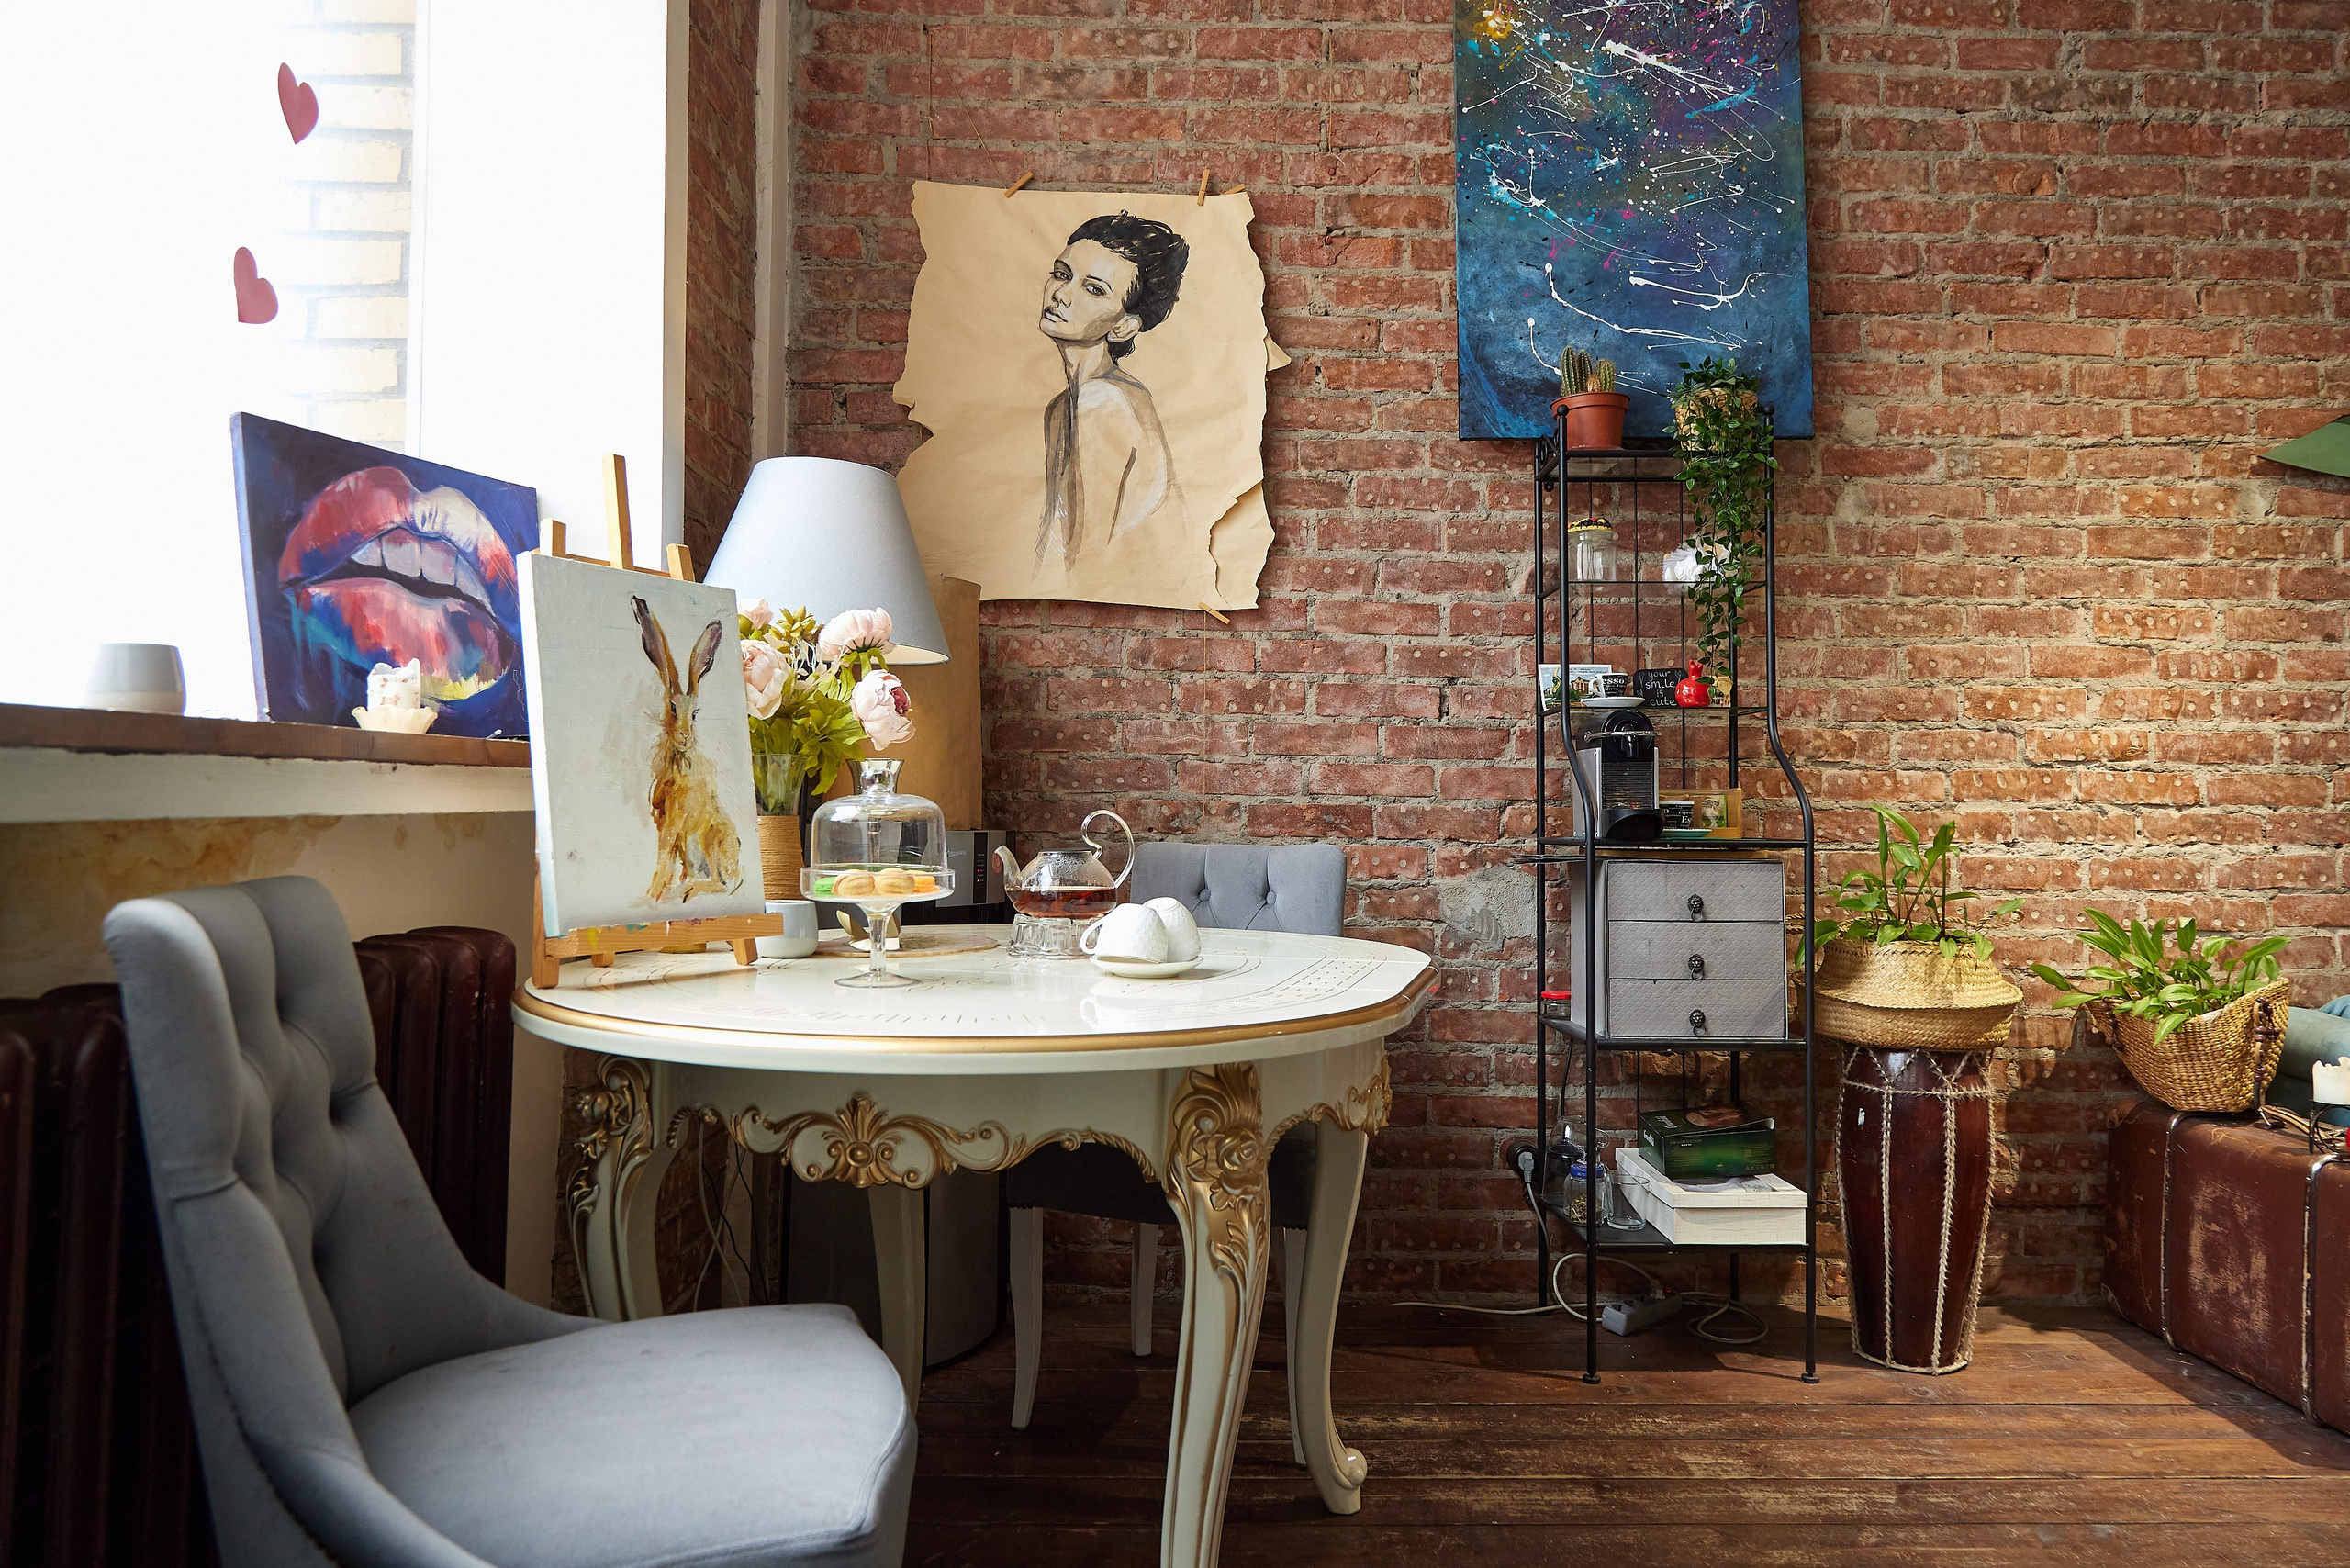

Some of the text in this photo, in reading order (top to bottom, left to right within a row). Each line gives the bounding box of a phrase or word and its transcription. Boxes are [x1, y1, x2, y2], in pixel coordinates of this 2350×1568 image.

[1648, 670, 1671, 681] your
[1645, 679, 1676, 689] smile
[1656, 689, 1664, 698] is
[1650, 697, 1677, 707] cute
